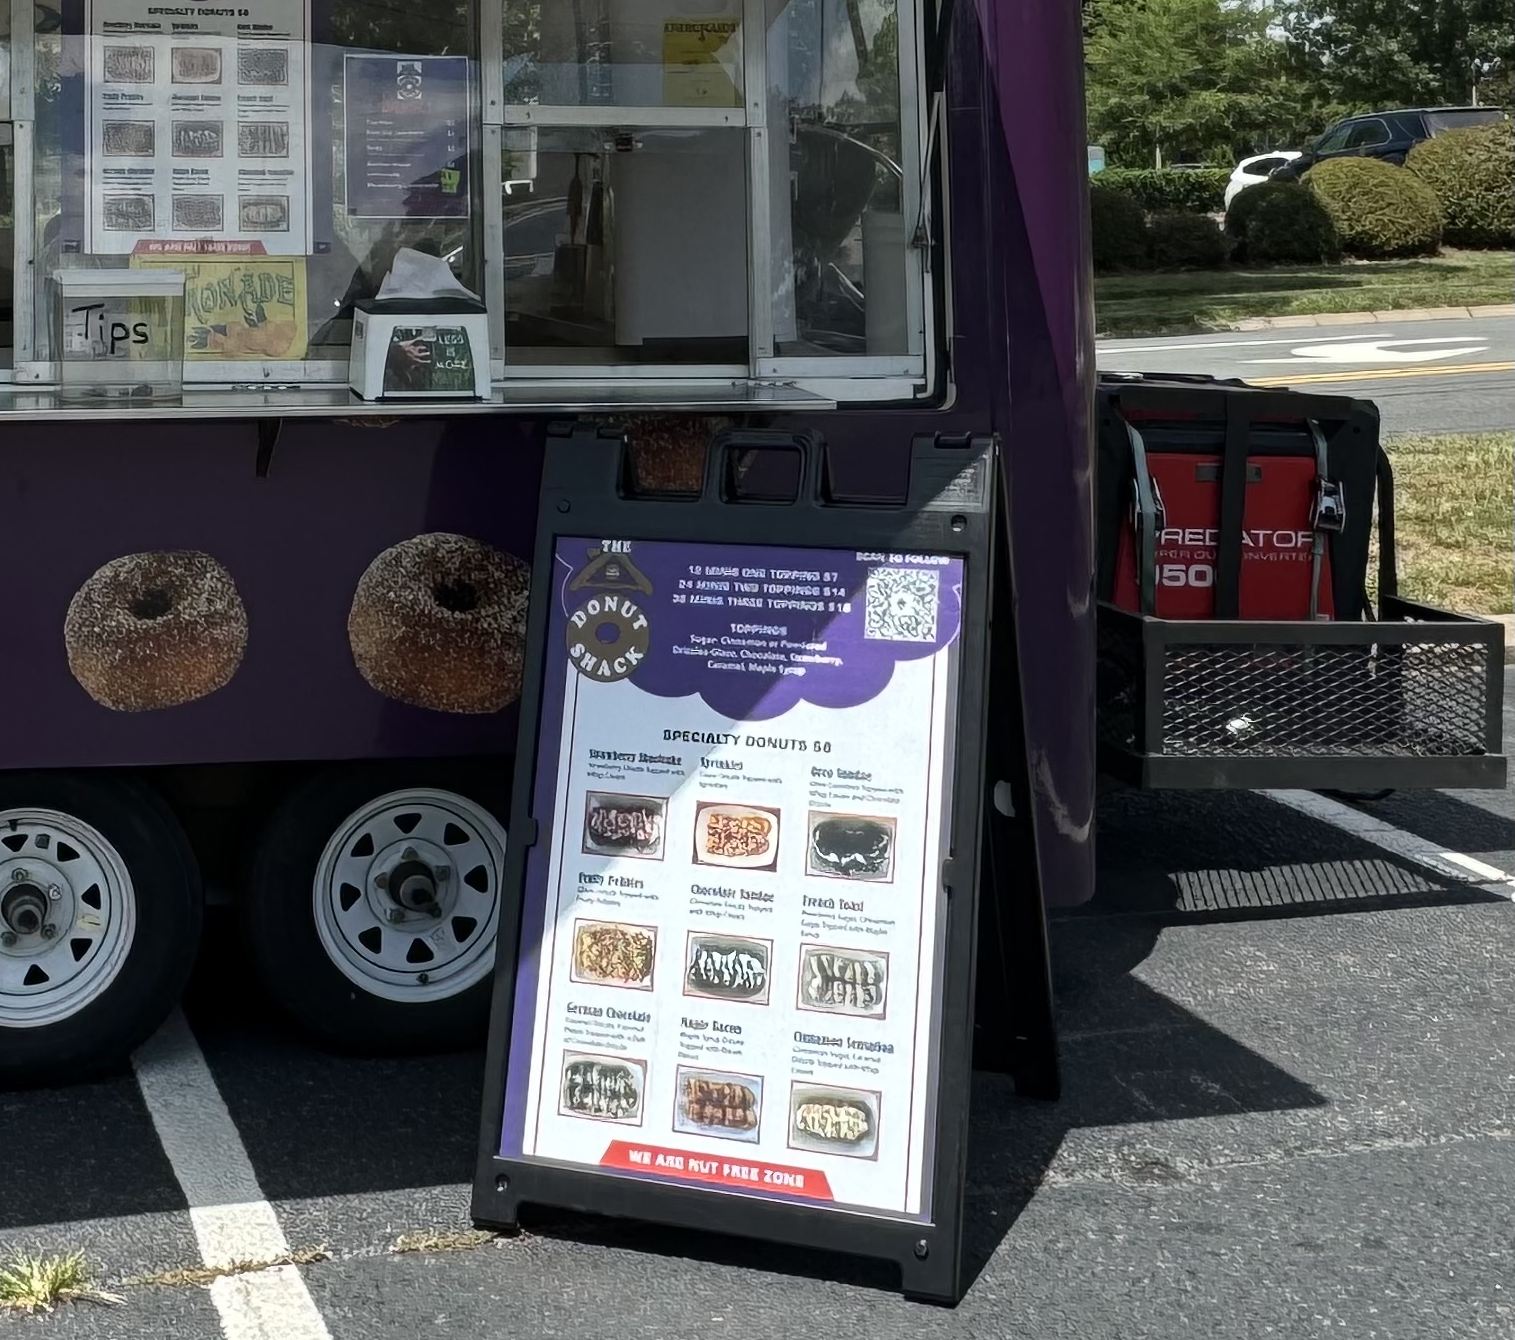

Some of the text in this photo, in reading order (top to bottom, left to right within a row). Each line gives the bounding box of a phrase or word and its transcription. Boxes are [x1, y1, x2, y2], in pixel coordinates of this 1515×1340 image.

[72, 303, 149, 355] Tips
[602, 540, 632, 553] THE
[571, 596, 648, 630] DONUT
[570, 643, 644, 677] SHACK
[663, 729, 741, 746] SPECIALTY
[745, 734, 808, 752] DONUTS
[628, 1149, 805, 1189] WE ARE NUT FREE ZONE
